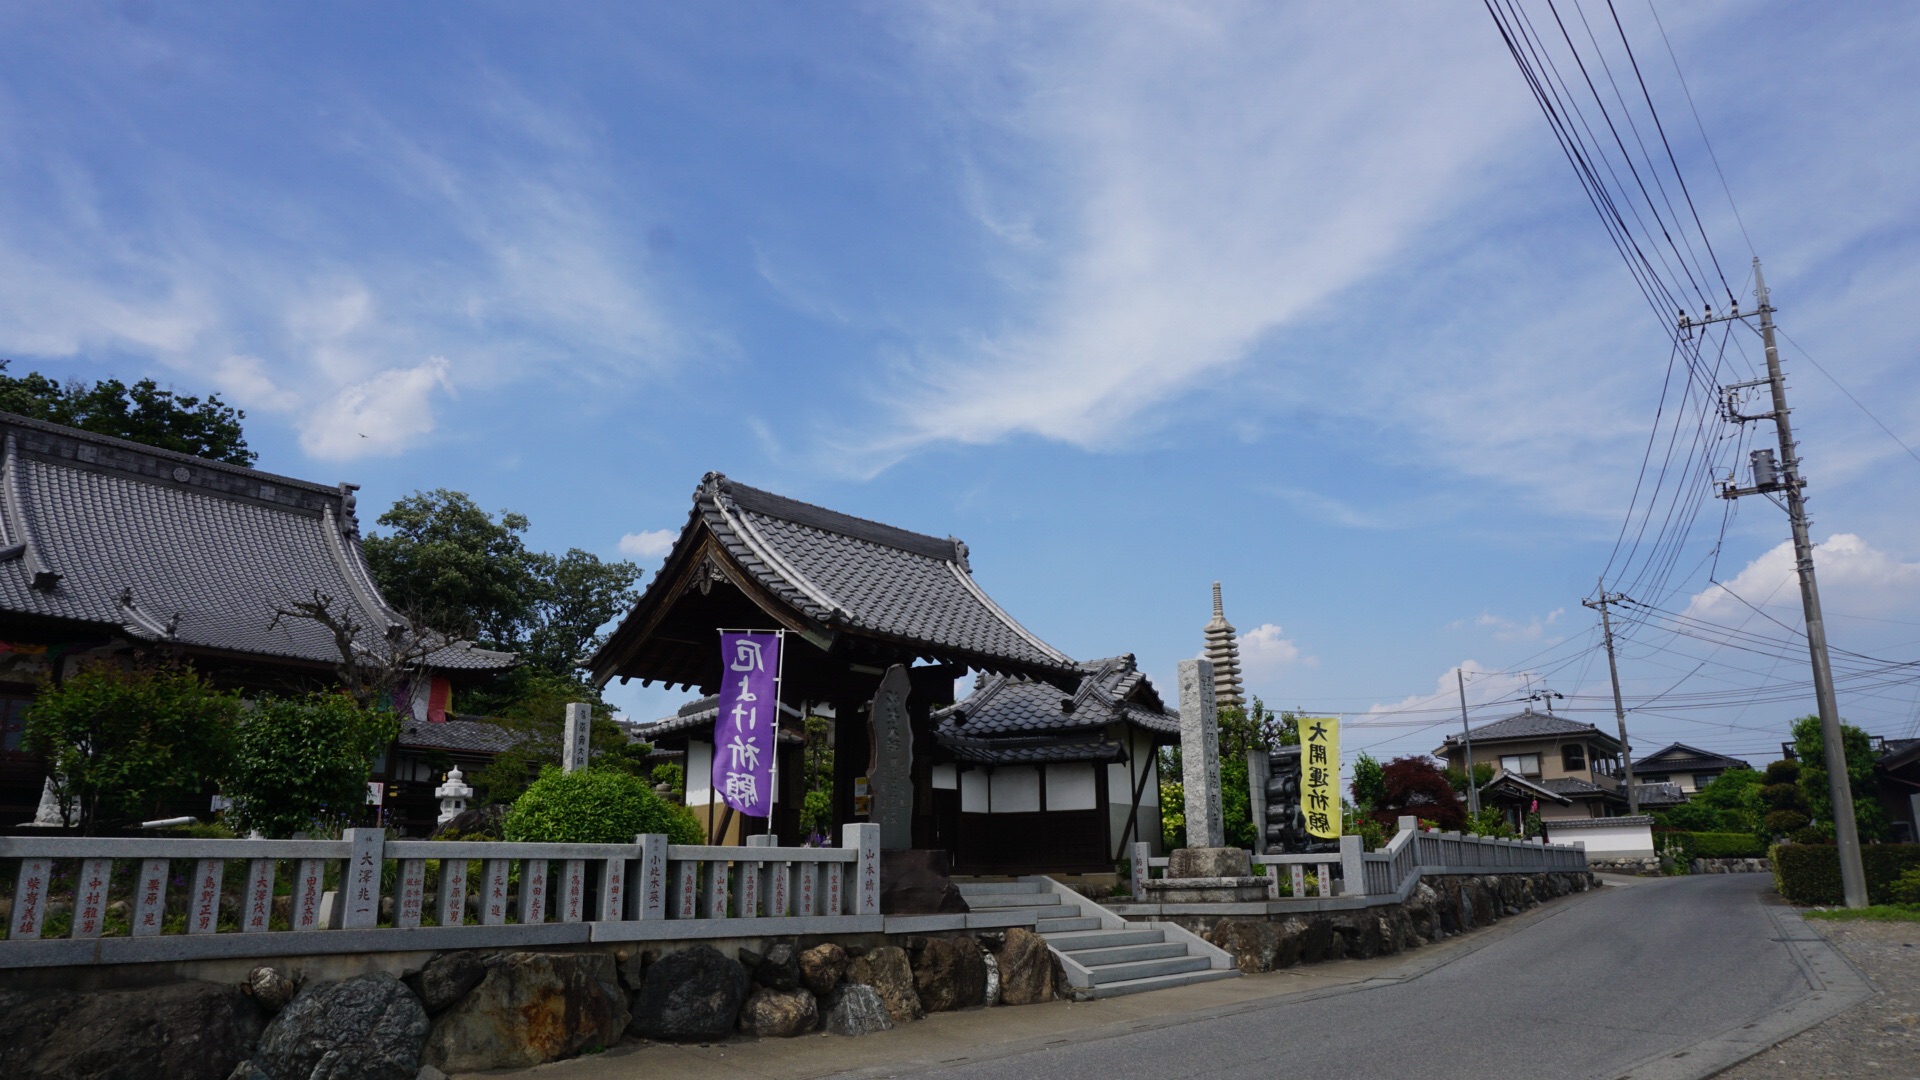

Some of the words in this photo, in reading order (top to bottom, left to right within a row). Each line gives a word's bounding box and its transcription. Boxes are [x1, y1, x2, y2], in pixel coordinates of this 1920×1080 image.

[82, 877, 103, 933] 中村雅男
[355, 851, 374, 913] 大澤兆一
